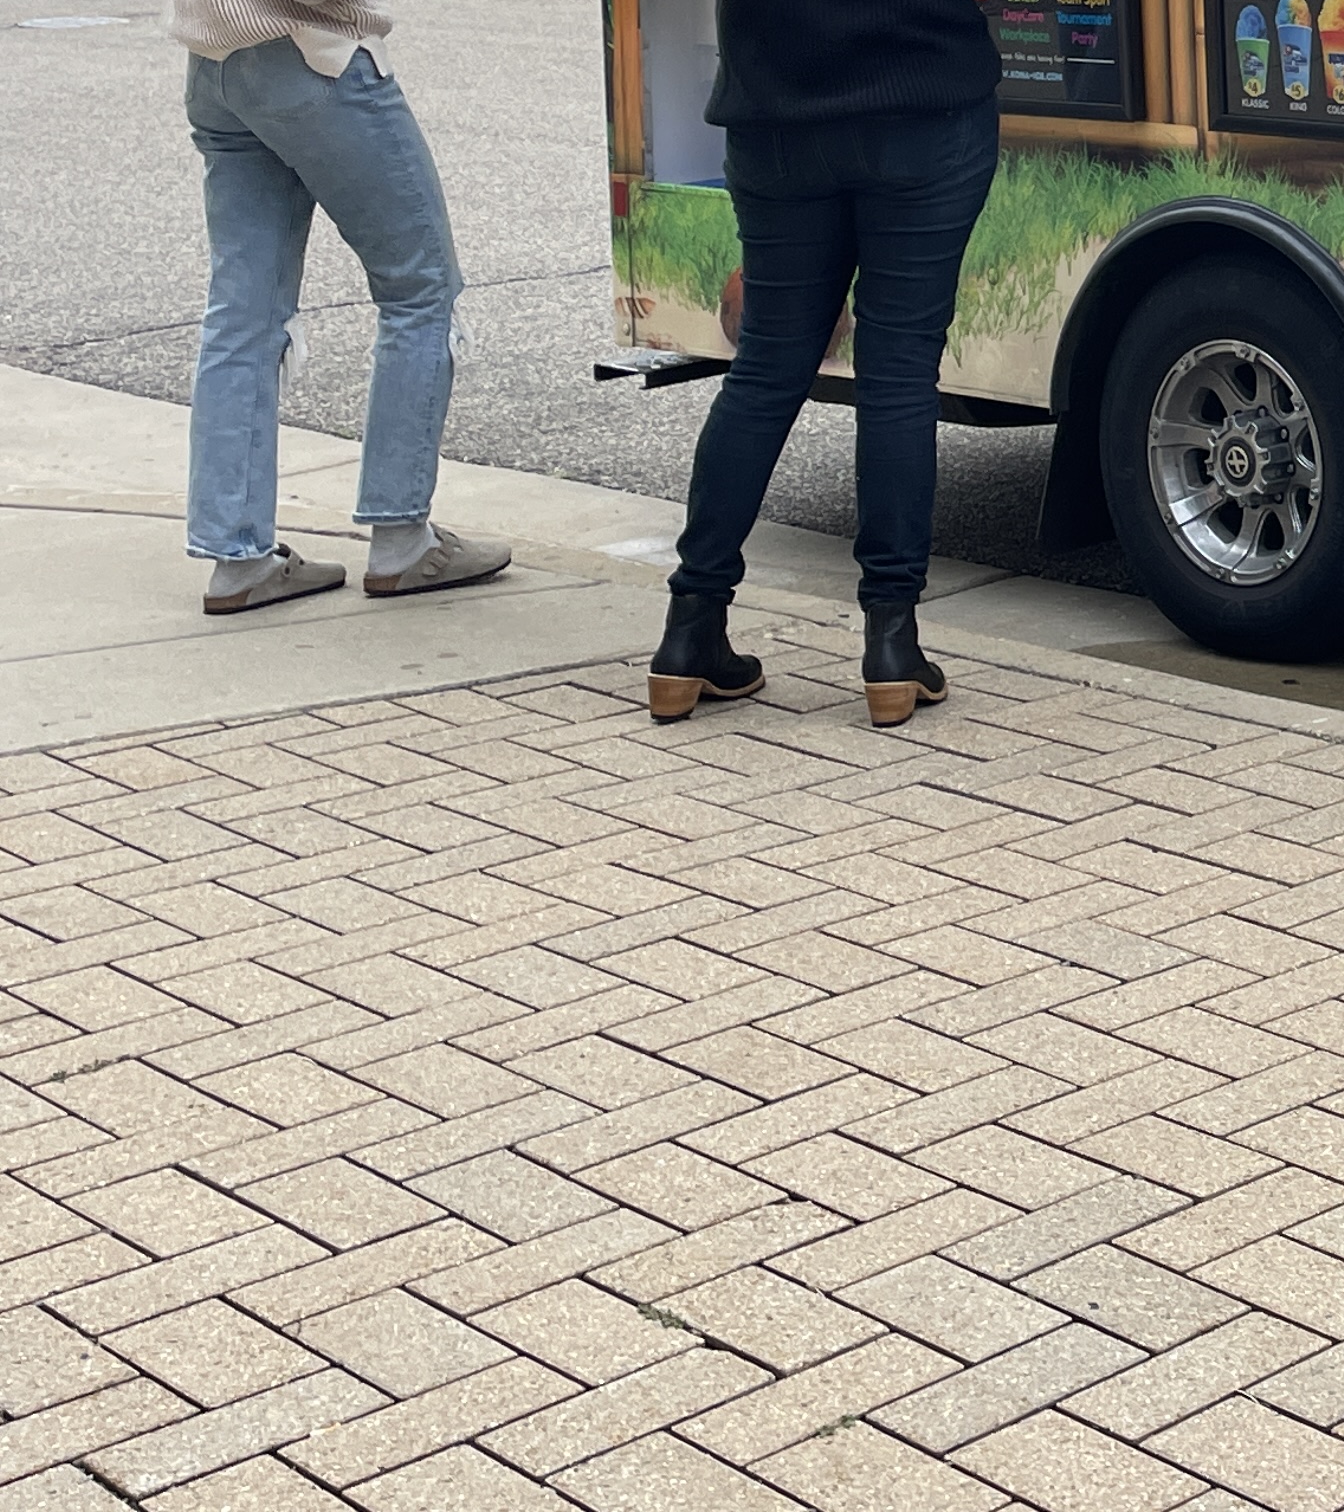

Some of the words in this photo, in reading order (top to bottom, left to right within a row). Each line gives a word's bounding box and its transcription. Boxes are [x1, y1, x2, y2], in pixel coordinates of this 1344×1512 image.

[1056, 11, 1112, 25] Tournament
[1071, 31, 1098, 48] Party
[1241, 98, 1269, 109] KLASSIC
